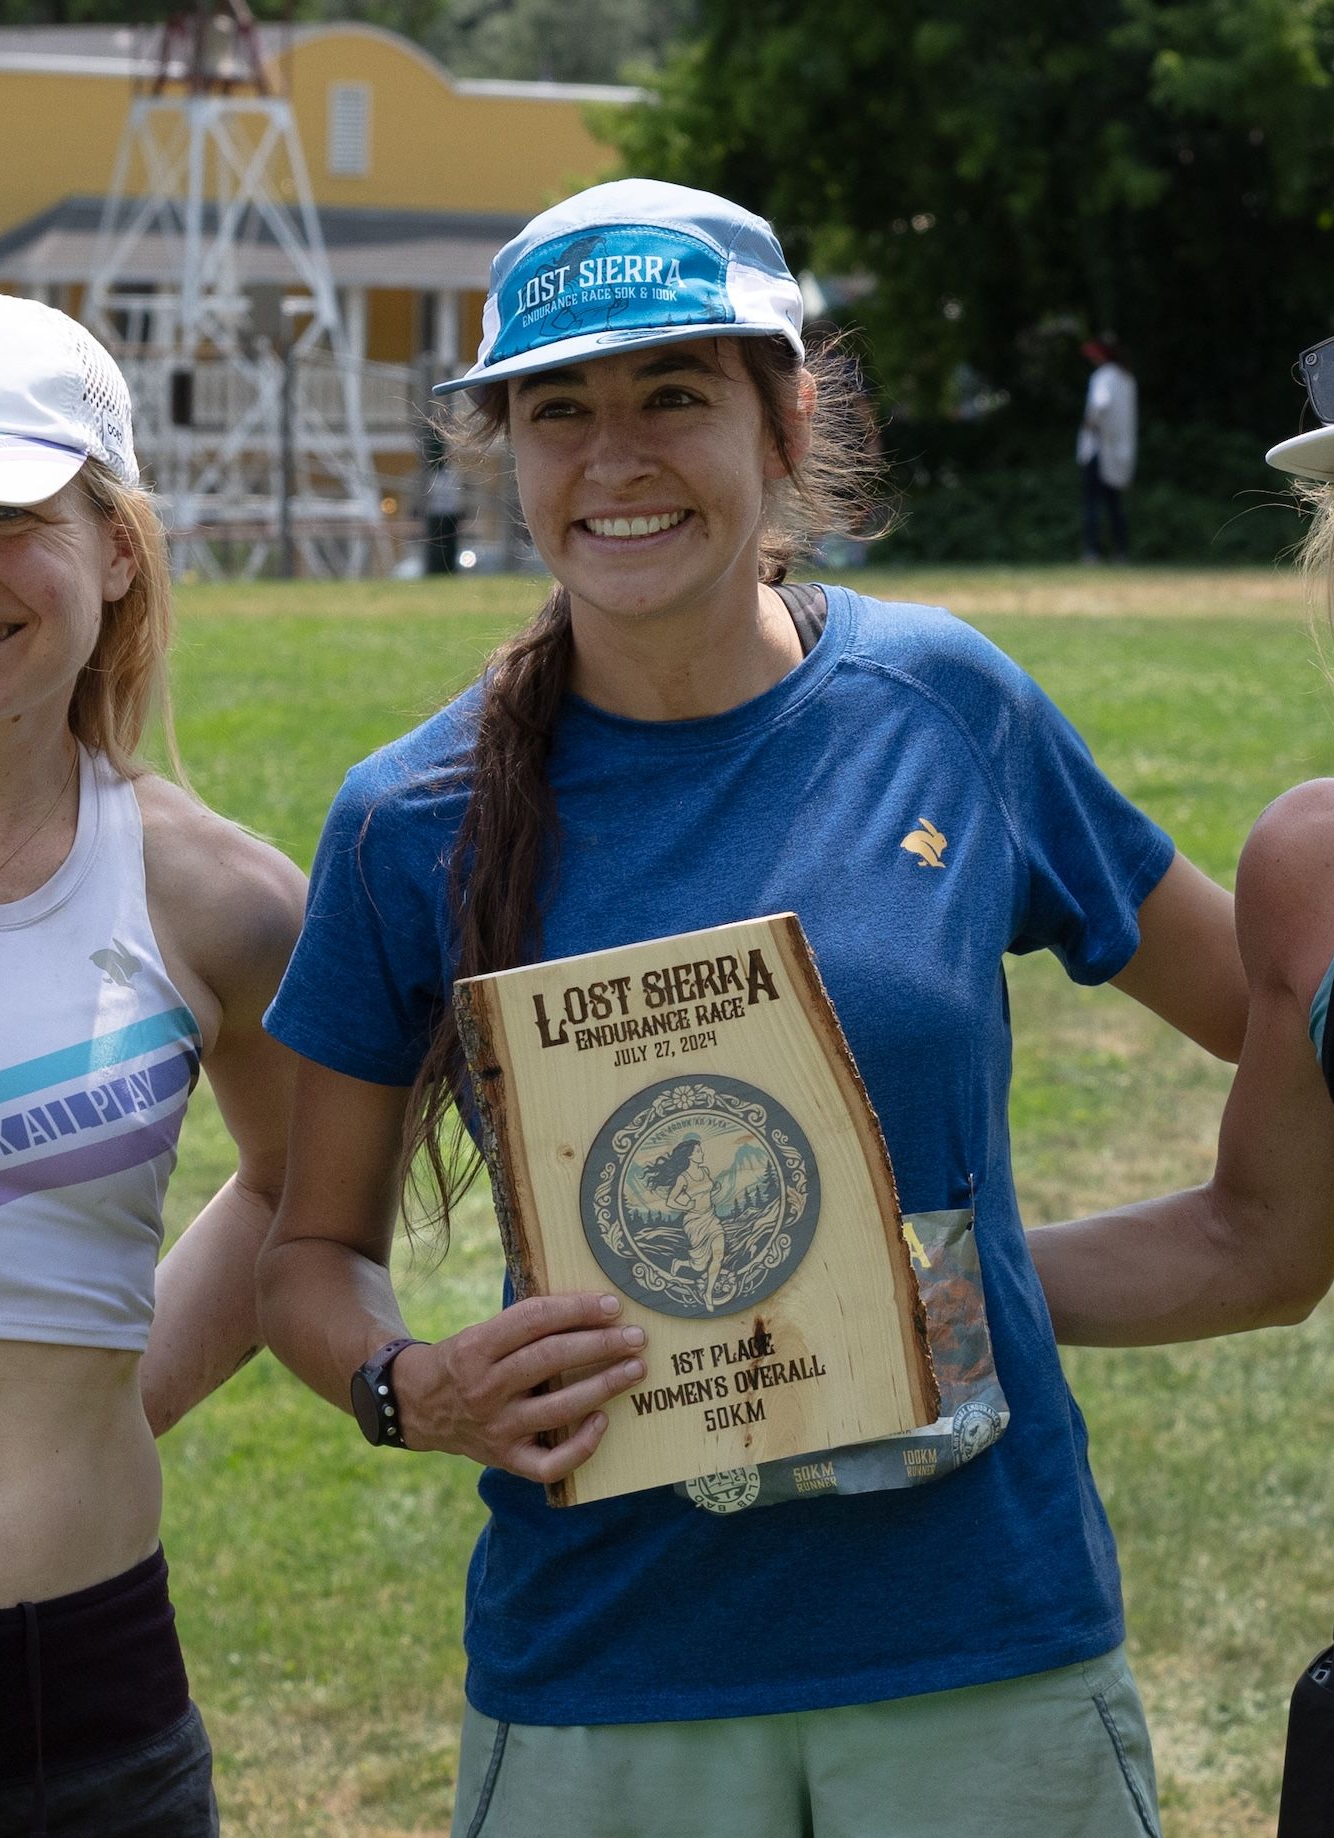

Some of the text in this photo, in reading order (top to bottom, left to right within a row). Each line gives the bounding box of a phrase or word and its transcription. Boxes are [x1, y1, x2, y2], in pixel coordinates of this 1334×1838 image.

[515, 256, 687, 316] LOST SIERRA
[522, 286, 678, 328] ENDURANCE RACE 50K & 100K
[532, 949, 780, 1048] LOST SIERRA
[575, 997, 746, 1051] ENDURANCE RACE
[614, 1031, 717, 1067] JULY 27, 2024
[22, 1098, 95, 1148] ALL
[88, 1068, 157, 1129] PLAY
[671, 1333, 775, 1376] 1ST PLACE
[631, 1355, 827, 1416] WOMEN'S OVERALL
[704, 1398, 767, 1432] 50KM
[793, 1461, 835, 1482] 50KM
[902, 1449, 937, 1466] 100KM
[906, 1464, 937, 1478] RUNNER
[796, 1476, 839, 1493] RUNNER
